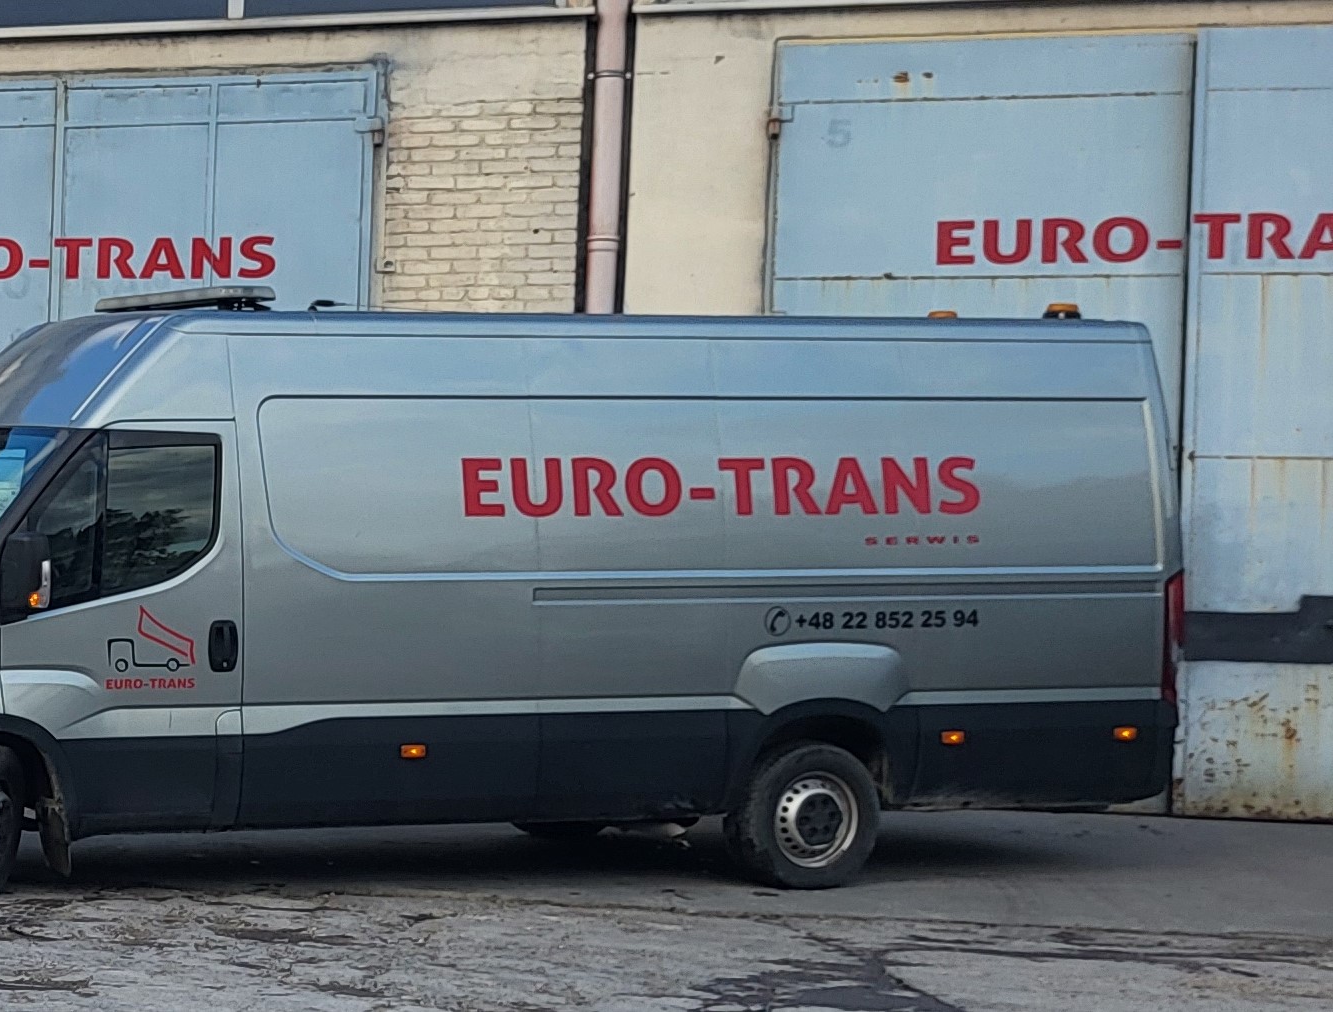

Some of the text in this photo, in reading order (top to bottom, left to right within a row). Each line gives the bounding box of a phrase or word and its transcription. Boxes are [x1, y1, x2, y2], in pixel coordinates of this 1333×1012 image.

[461, 456, 981, 518] EURO-TRANS
[865, 535, 980, 545] SERWIS
[795, 609, 978, 629] +48 22 852 25 94
[105, 678, 195, 690] EURO-TRANS
